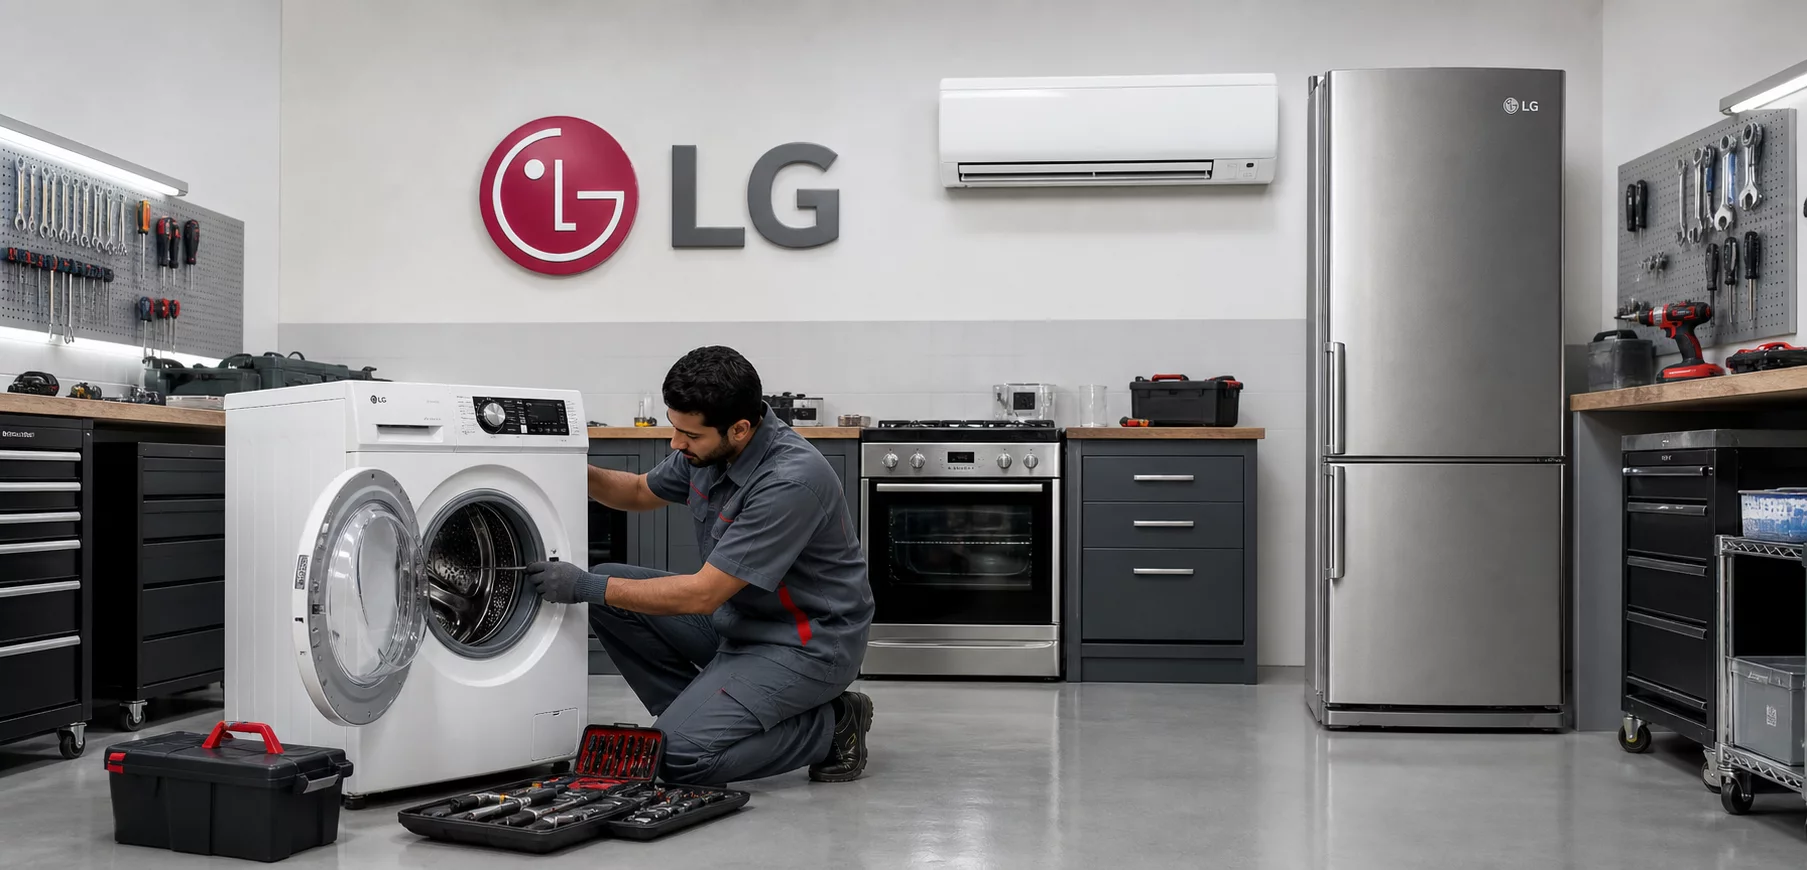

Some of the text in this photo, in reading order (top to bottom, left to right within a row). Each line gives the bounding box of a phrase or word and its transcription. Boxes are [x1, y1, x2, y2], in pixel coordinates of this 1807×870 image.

[1522, 100, 1539, 112] LG
[671, 141, 840, 250] LG
[377, 396, 387, 404] LG
